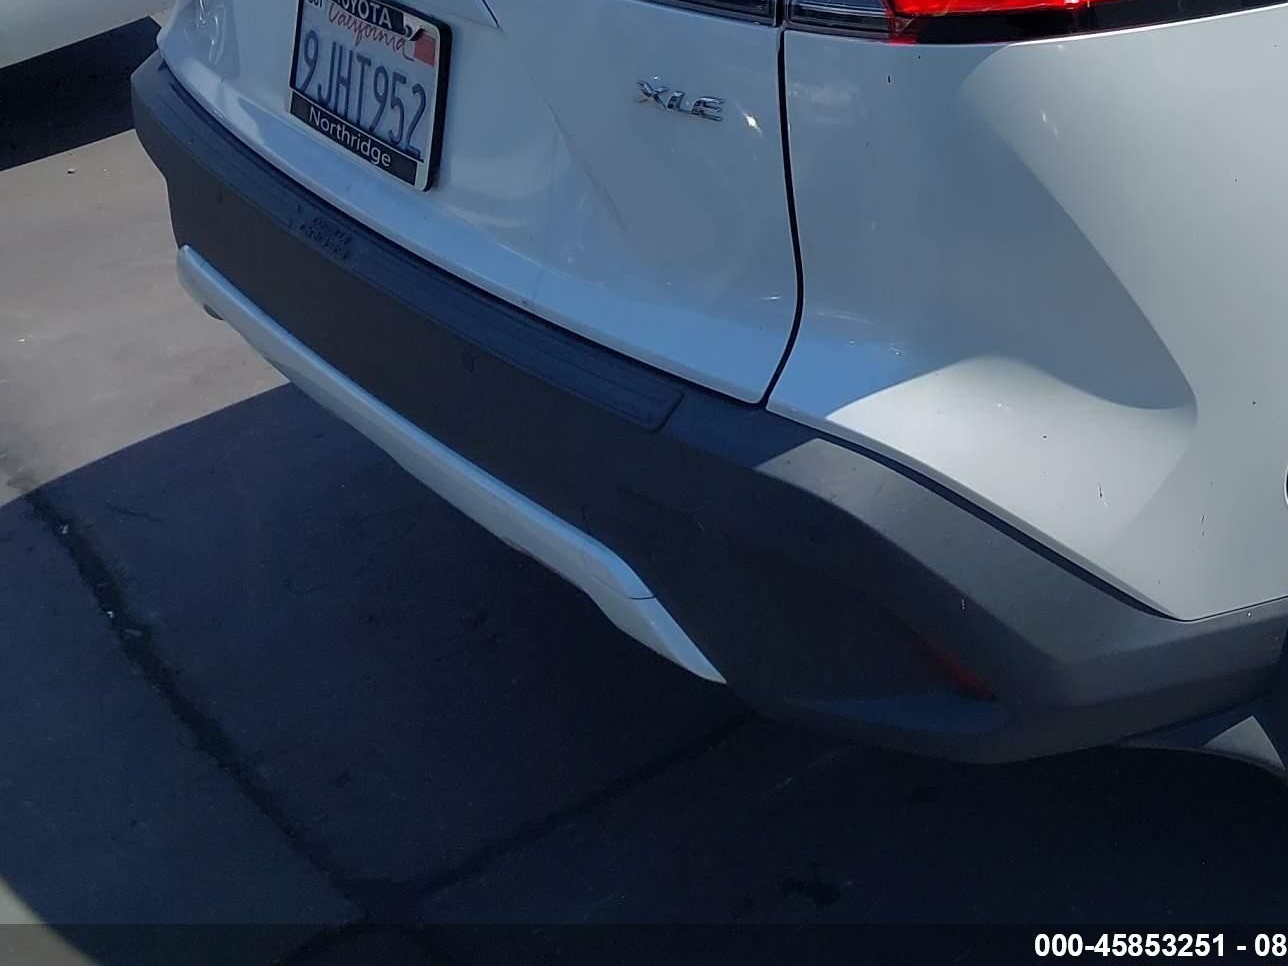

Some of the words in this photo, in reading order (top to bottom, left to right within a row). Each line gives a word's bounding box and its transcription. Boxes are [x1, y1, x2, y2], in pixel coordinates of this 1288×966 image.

[296, 29, 426, 158] 9JHT952
[637, 79, 724, 122] XLE
[310, 106, 391, 167] Northridge
